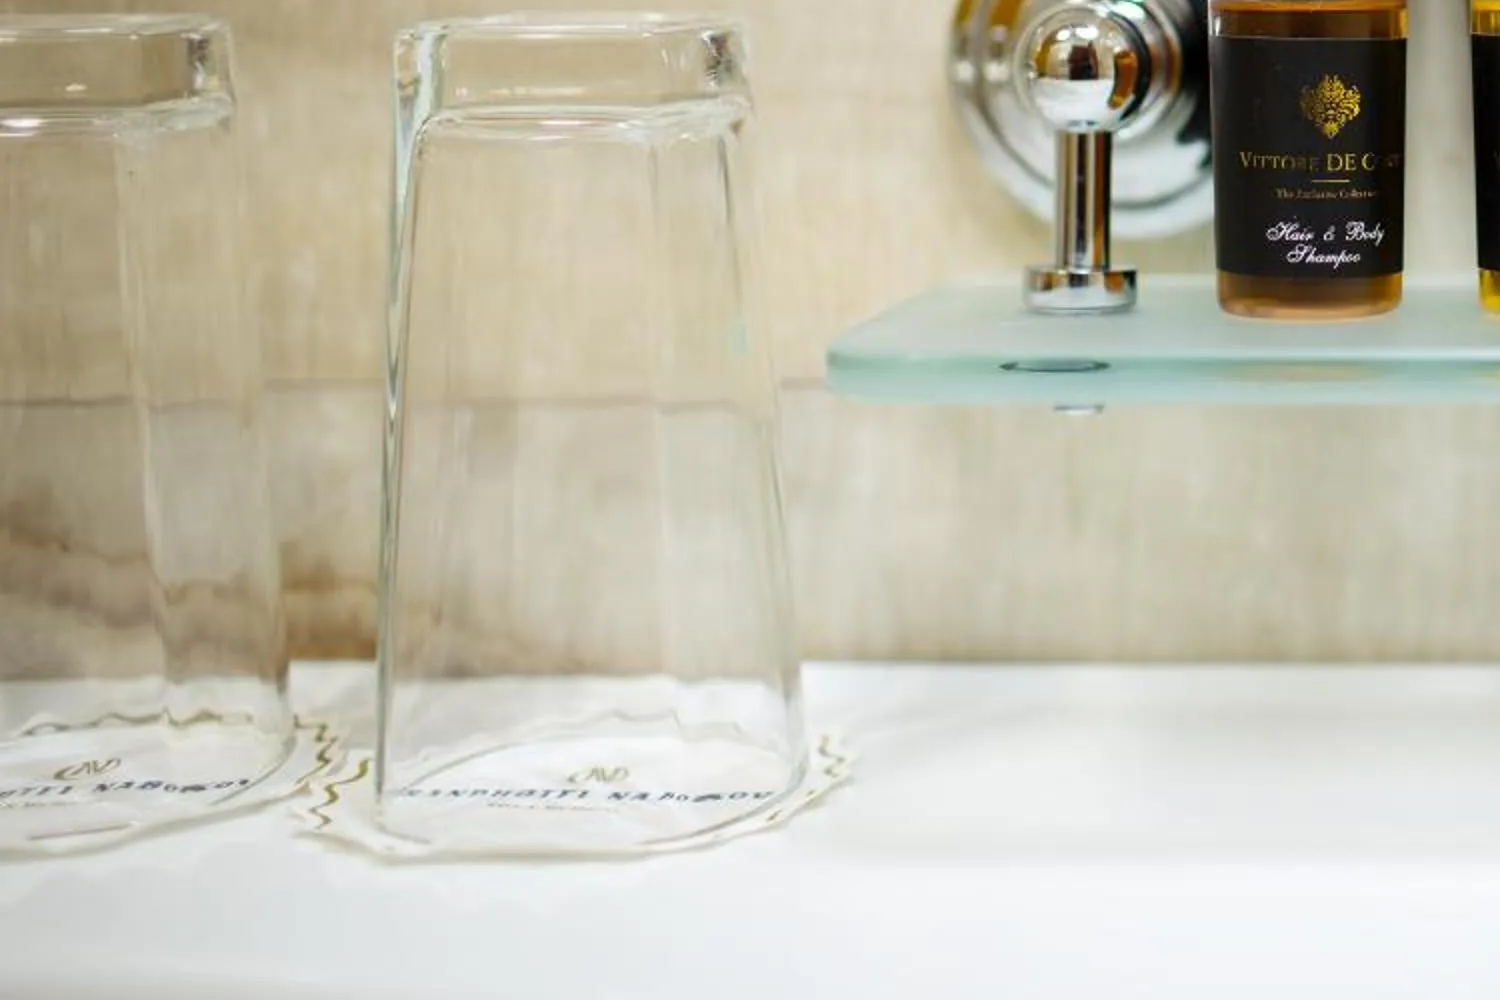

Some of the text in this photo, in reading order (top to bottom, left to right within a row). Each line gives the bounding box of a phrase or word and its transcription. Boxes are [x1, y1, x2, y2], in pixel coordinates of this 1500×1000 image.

[1327, 153, 1356, 171] DE
[1266, 220, 1385, 246] Hair & Body
[1286, 243, 1361, 269] Shampoo
